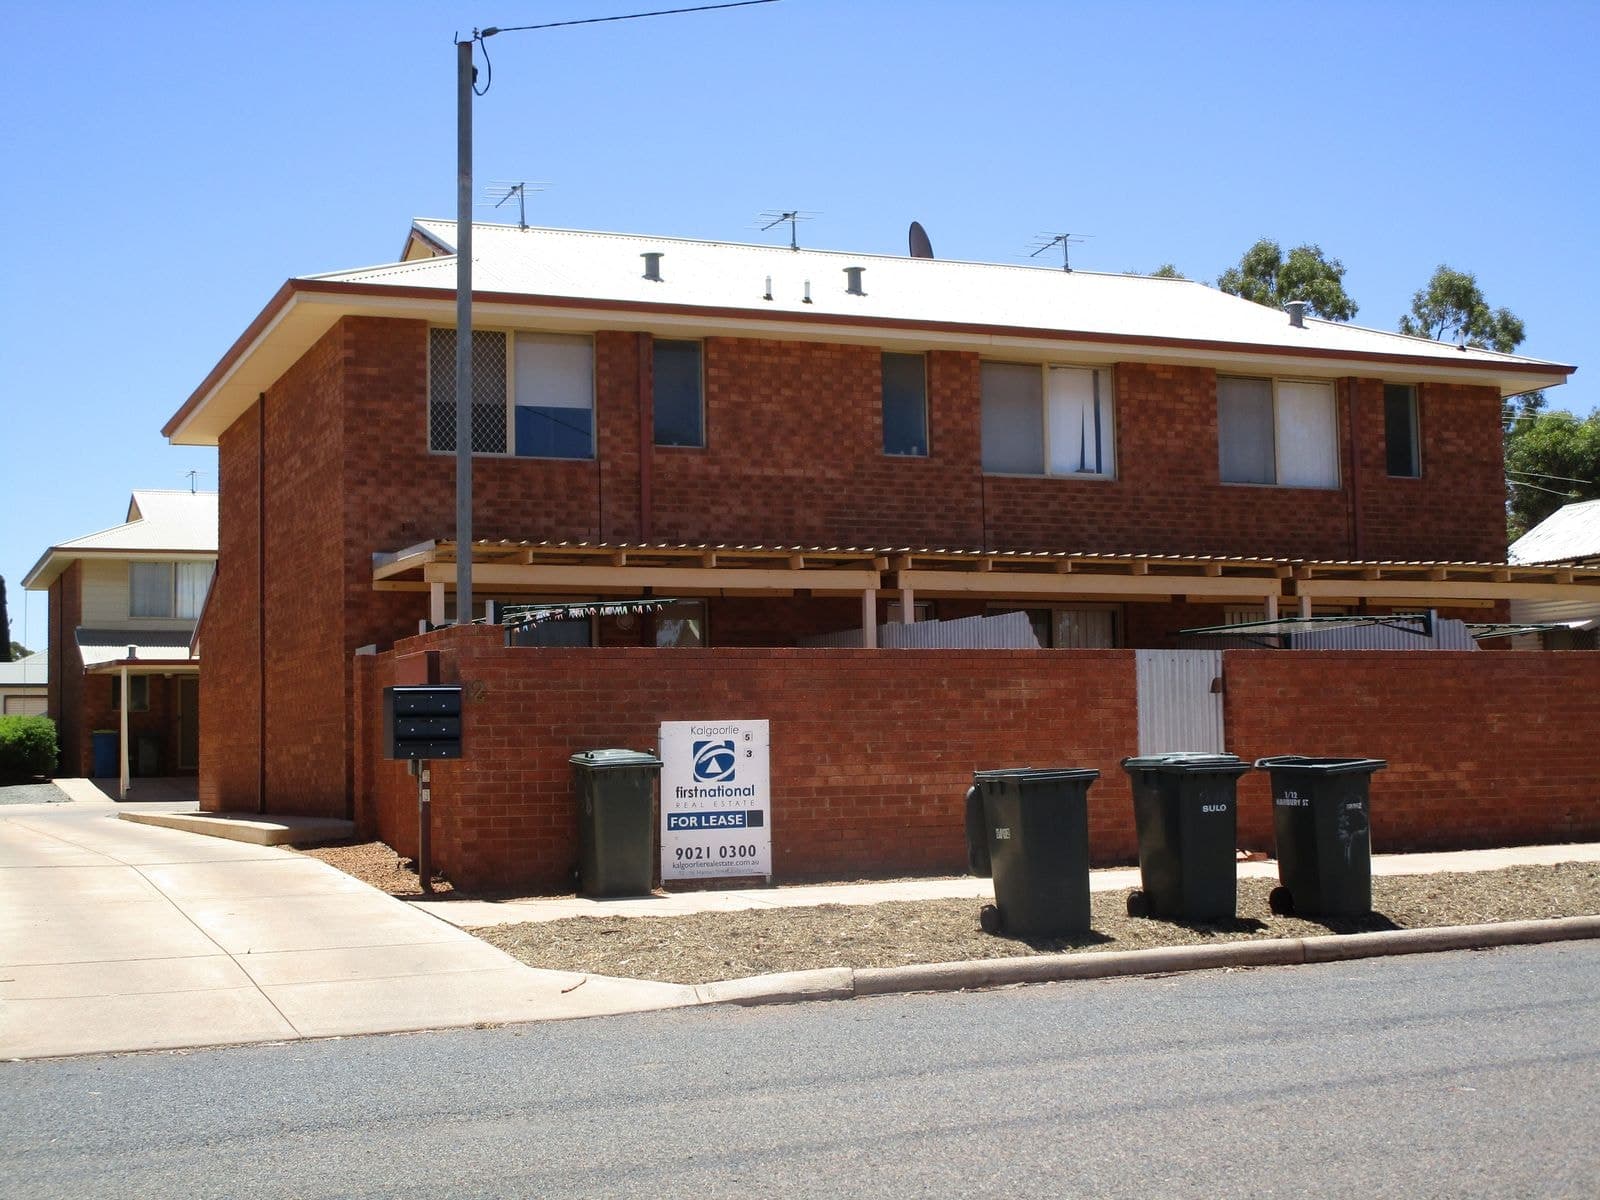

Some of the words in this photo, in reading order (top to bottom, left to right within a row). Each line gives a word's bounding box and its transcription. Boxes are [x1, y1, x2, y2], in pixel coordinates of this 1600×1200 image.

[690, 725, 739, 737] Kalgoorlie
[744, 733, 751, 741] 5
[746, 749, 753, 758] 3
[676, 784, 755, 798] firstnational
[1202, 803, 1227, 812] SULO
[670, 816, 698, 828] FOR
[702, 814, 743, 826] LEASE
[675, 846, 710, 860] 9021
[719, 844, 756, 858] 0300
